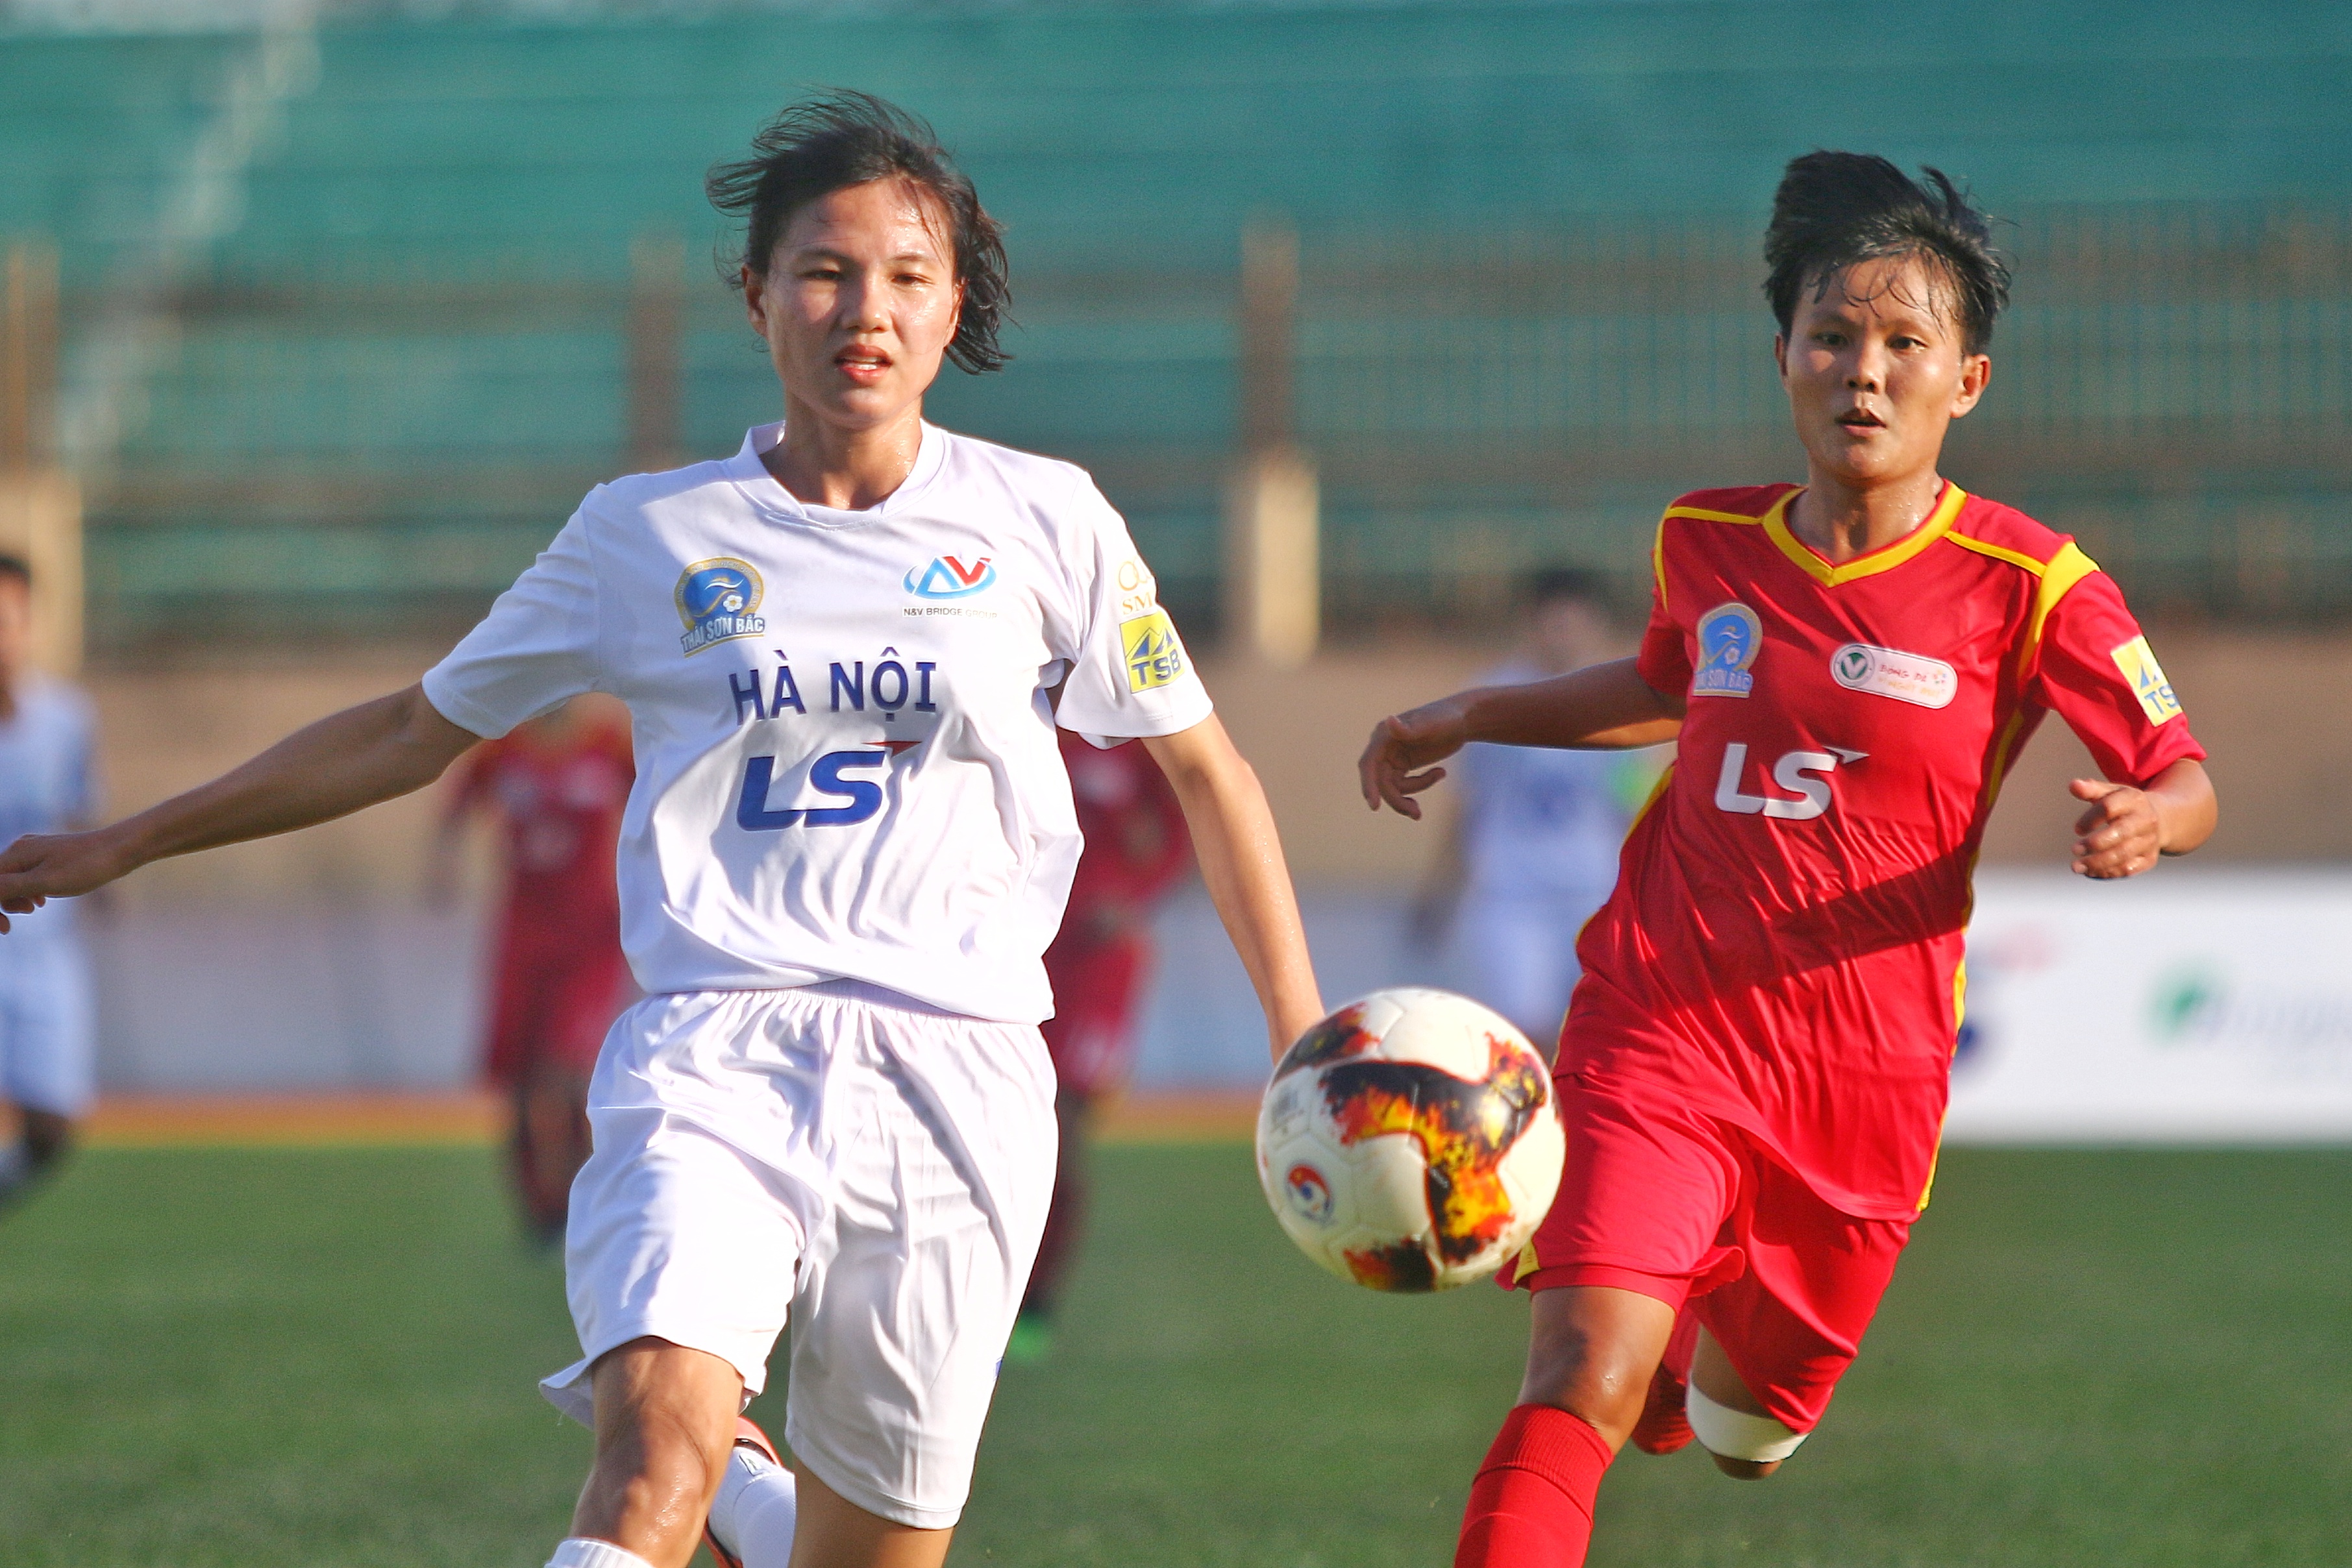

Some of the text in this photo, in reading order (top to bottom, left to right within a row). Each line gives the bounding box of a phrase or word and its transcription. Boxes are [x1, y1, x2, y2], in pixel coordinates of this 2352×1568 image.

[682, 614, 764, 652] THÁI SƠN BẮC
[903, 607, 997, 620] N&V BRIDGE GROUP
[728, 646, 937, 726] HÀ NỘI
[1130, 648, 1182, 686] TSB
[736, 750, 887, 832] LS
[1714, 743, 1838, 820] LS
